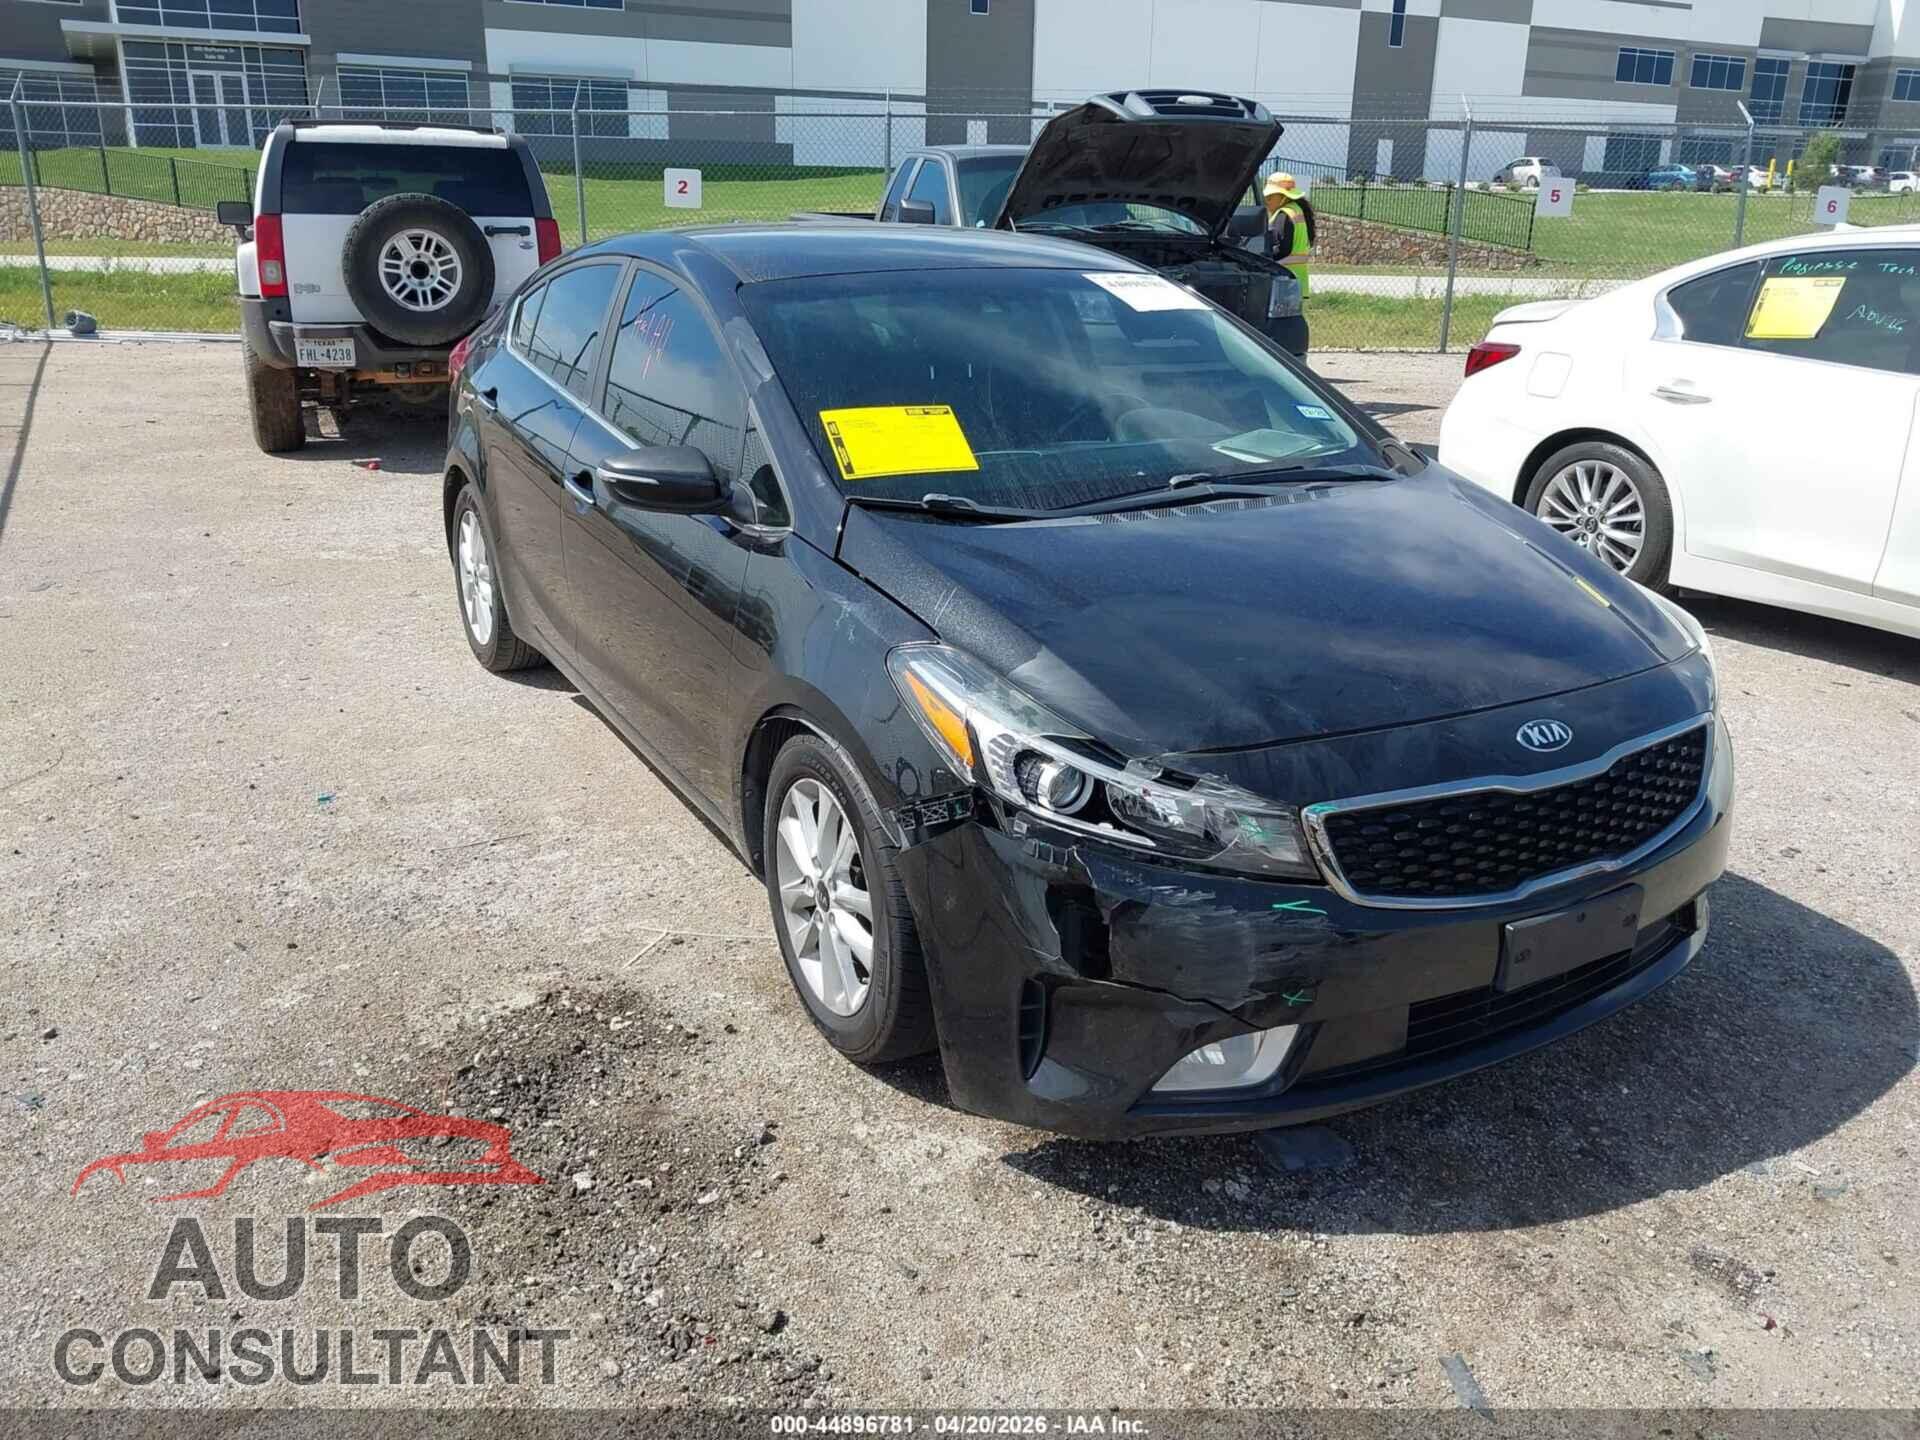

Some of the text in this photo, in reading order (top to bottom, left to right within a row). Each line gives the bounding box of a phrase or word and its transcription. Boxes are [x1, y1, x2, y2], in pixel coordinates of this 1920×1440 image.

[677, 180, 688, 194] 2
[1551, 189, 1561, 203] 5
[1827, 199, 1838, 213] 6
[1522, 722, 1569, 746] KIA
